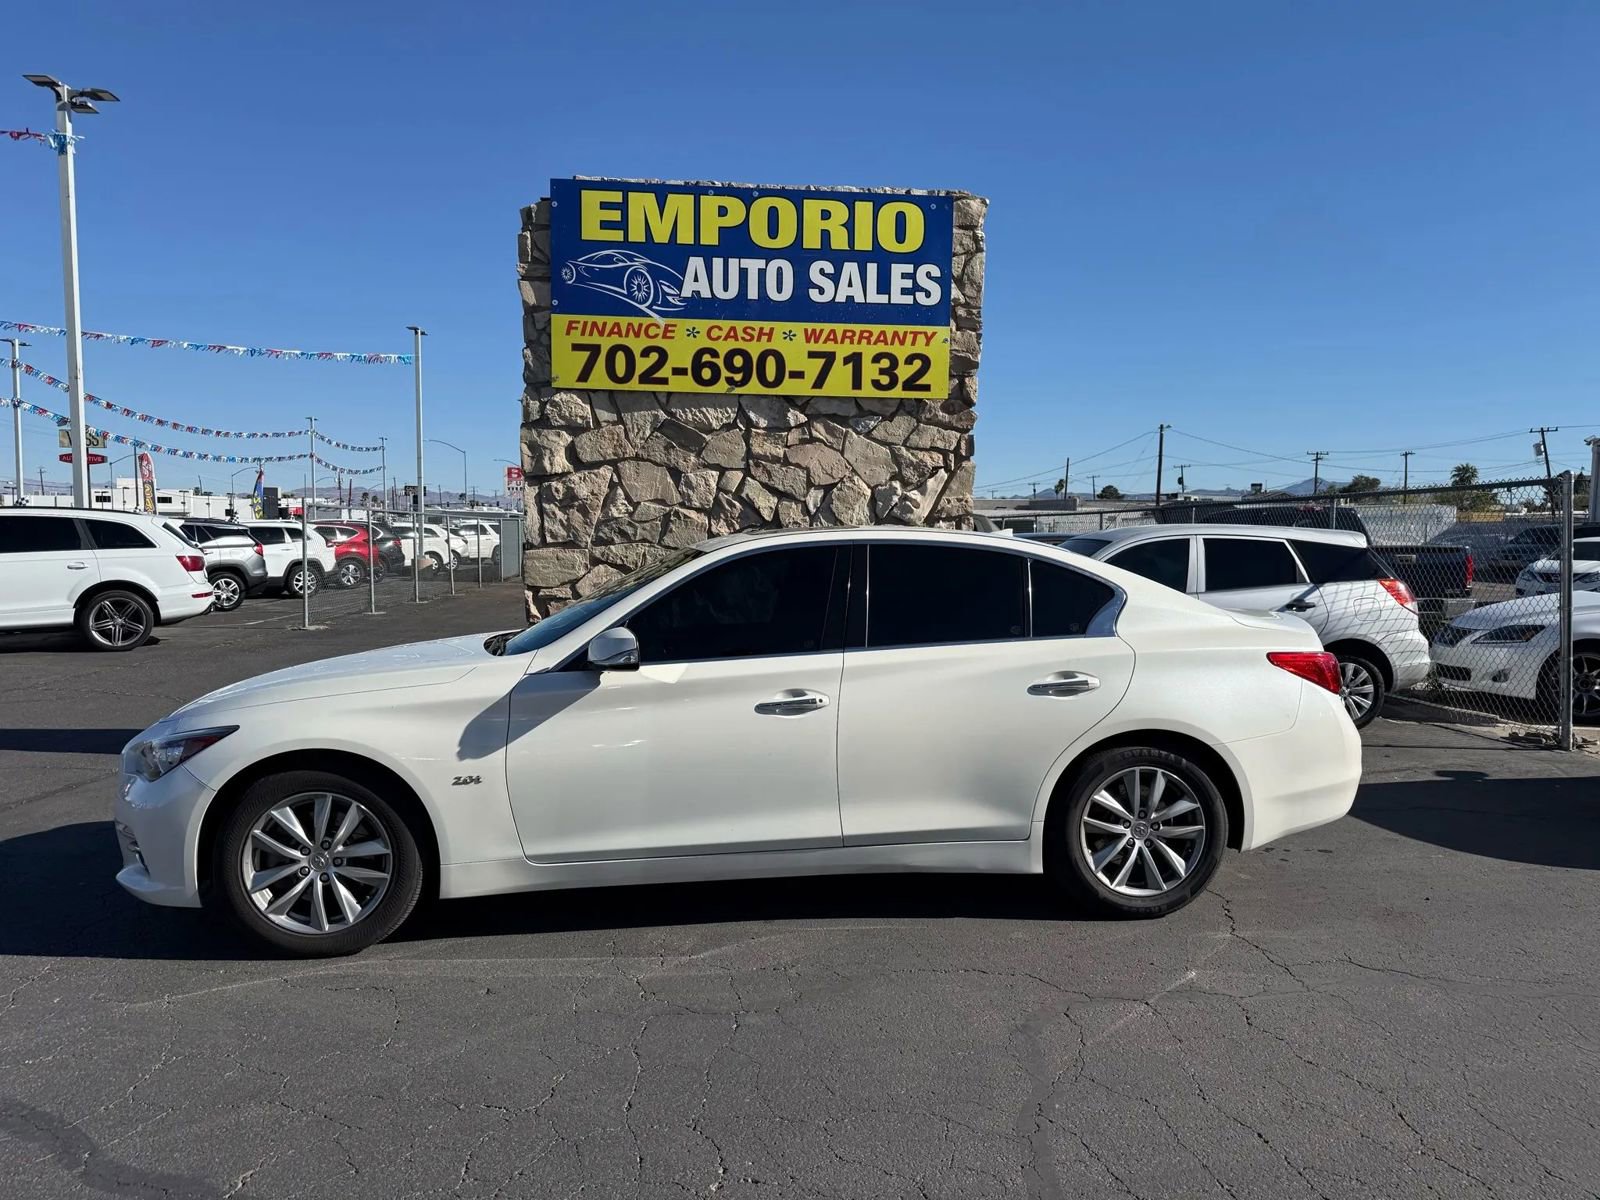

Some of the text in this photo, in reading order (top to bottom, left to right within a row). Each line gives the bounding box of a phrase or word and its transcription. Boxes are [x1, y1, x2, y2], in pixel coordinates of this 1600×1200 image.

[580, 189, 925, 254] EMPORIO
[680, 256, 942, 307] AUTO SALES
[565, 319, 938, 347] FINANCE CASH WARRANTY
[570, 343, 932, 392] 702-690-7132
